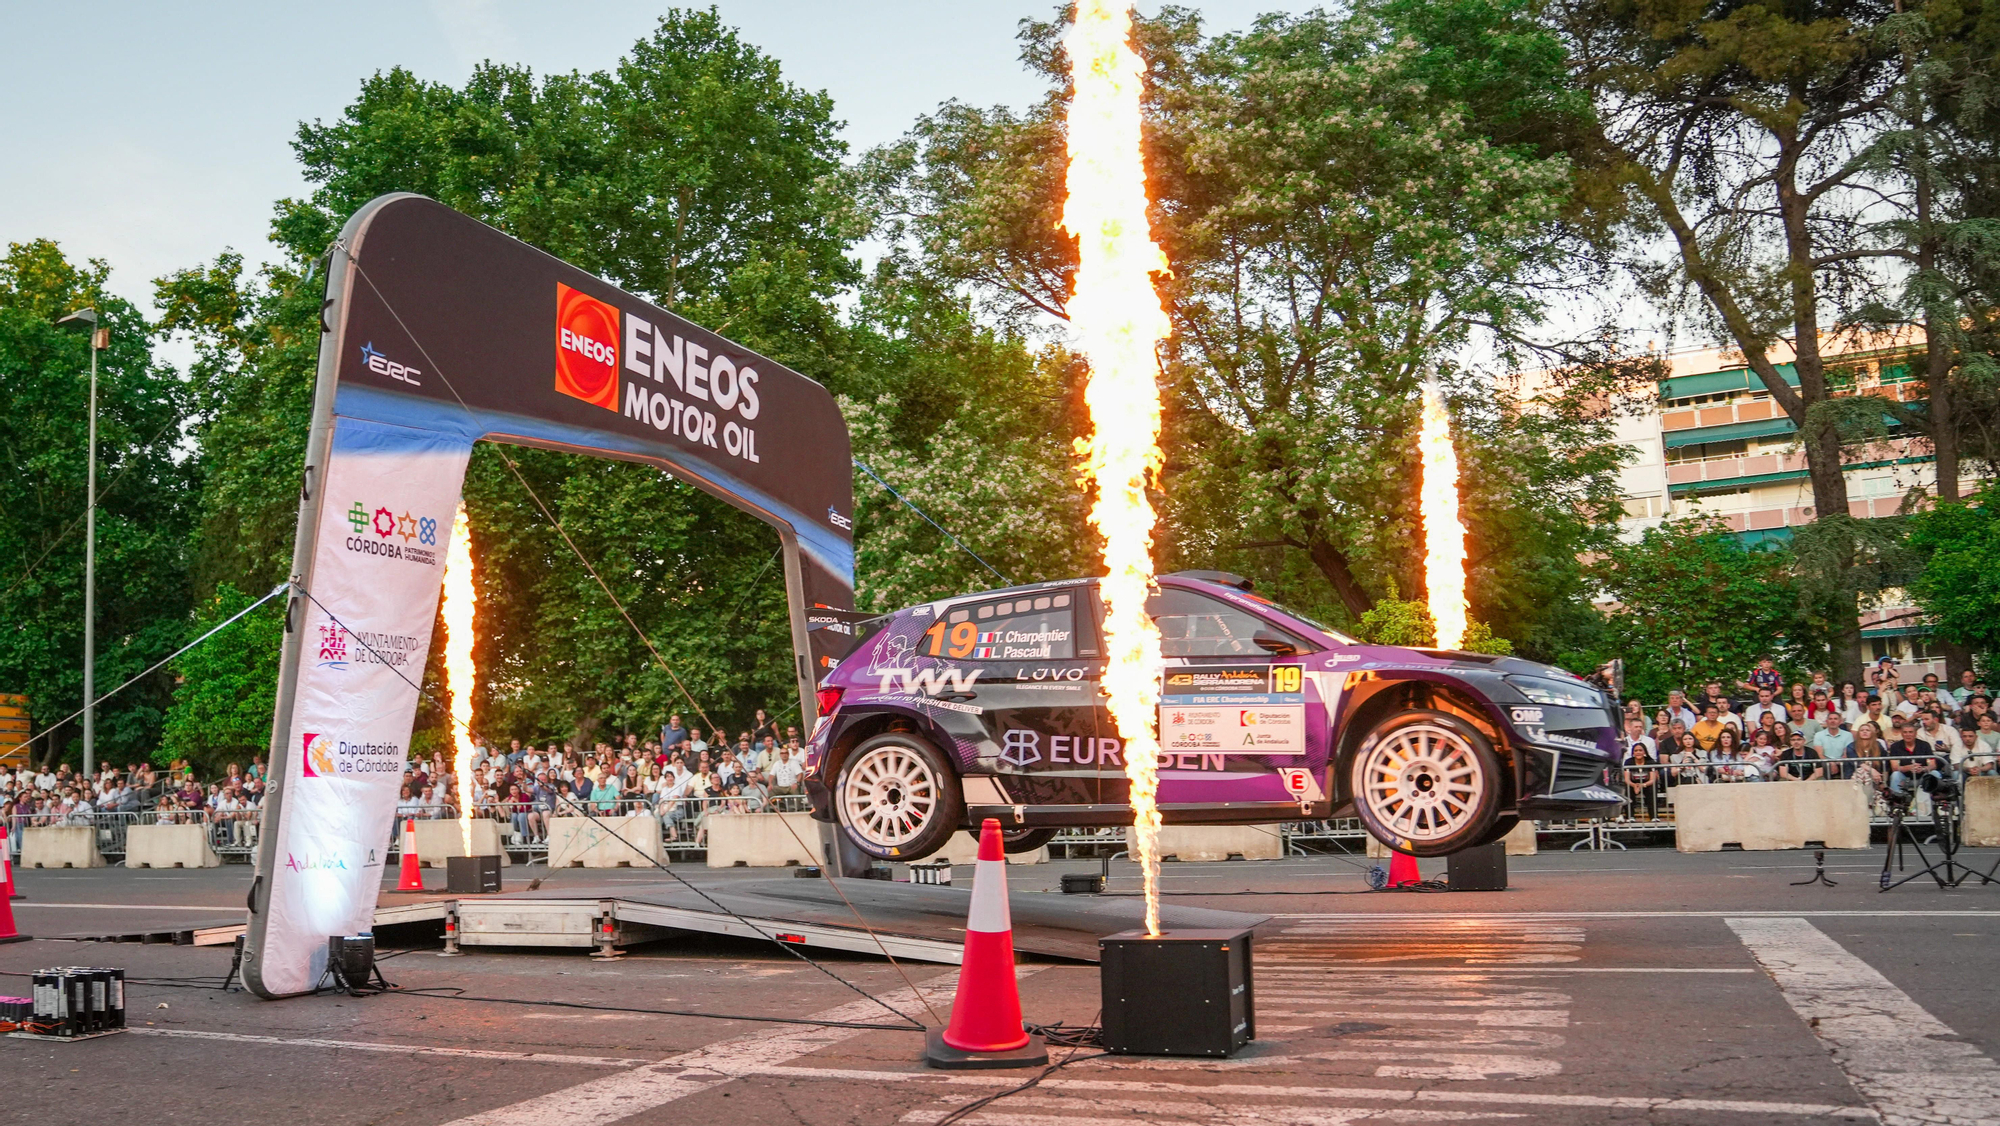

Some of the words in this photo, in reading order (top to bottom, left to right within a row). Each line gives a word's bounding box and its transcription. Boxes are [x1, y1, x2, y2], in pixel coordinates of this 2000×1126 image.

[561, 327, 615, 367] ENEOS
[369, 355, 422, 387] ERC
[625, 312, 760, 420] ENEOS
[624, 382, 718, 449] MOTOR
[723, 421, 760, 464] OIL
[346, 536, 403, 559] CÓRDOBA
[355, 631, 419, 651] AYUNTAMIENTO
[926, 621, 979, 659] 19
[994, 632, 1003, 643] T.
[1005, 629, 1070, 645] Charpentier
[354, 648, 366, 662] DE
[991, 646, 1001, 658] L.
[1003, 645, 1052, 659] Pascaud
[1167, 674, 1193, 686] 43
[1272, 667, 1301, 692] 19
[1193, 696, 1205, 704] FIA
[1206, 696, 1220, 704] ERC
[1221, 696, 1270, 704] Championship
[1512, 710, 1544, 721] OMP
[1548, 733, 1598, 749] MICHELIN
[339, 741, 399, 759] Diputación
[339, 759, 353, 773] de
[355, 758, 399, 773] Córdoba
[1291, 774, 1304, 790] E
